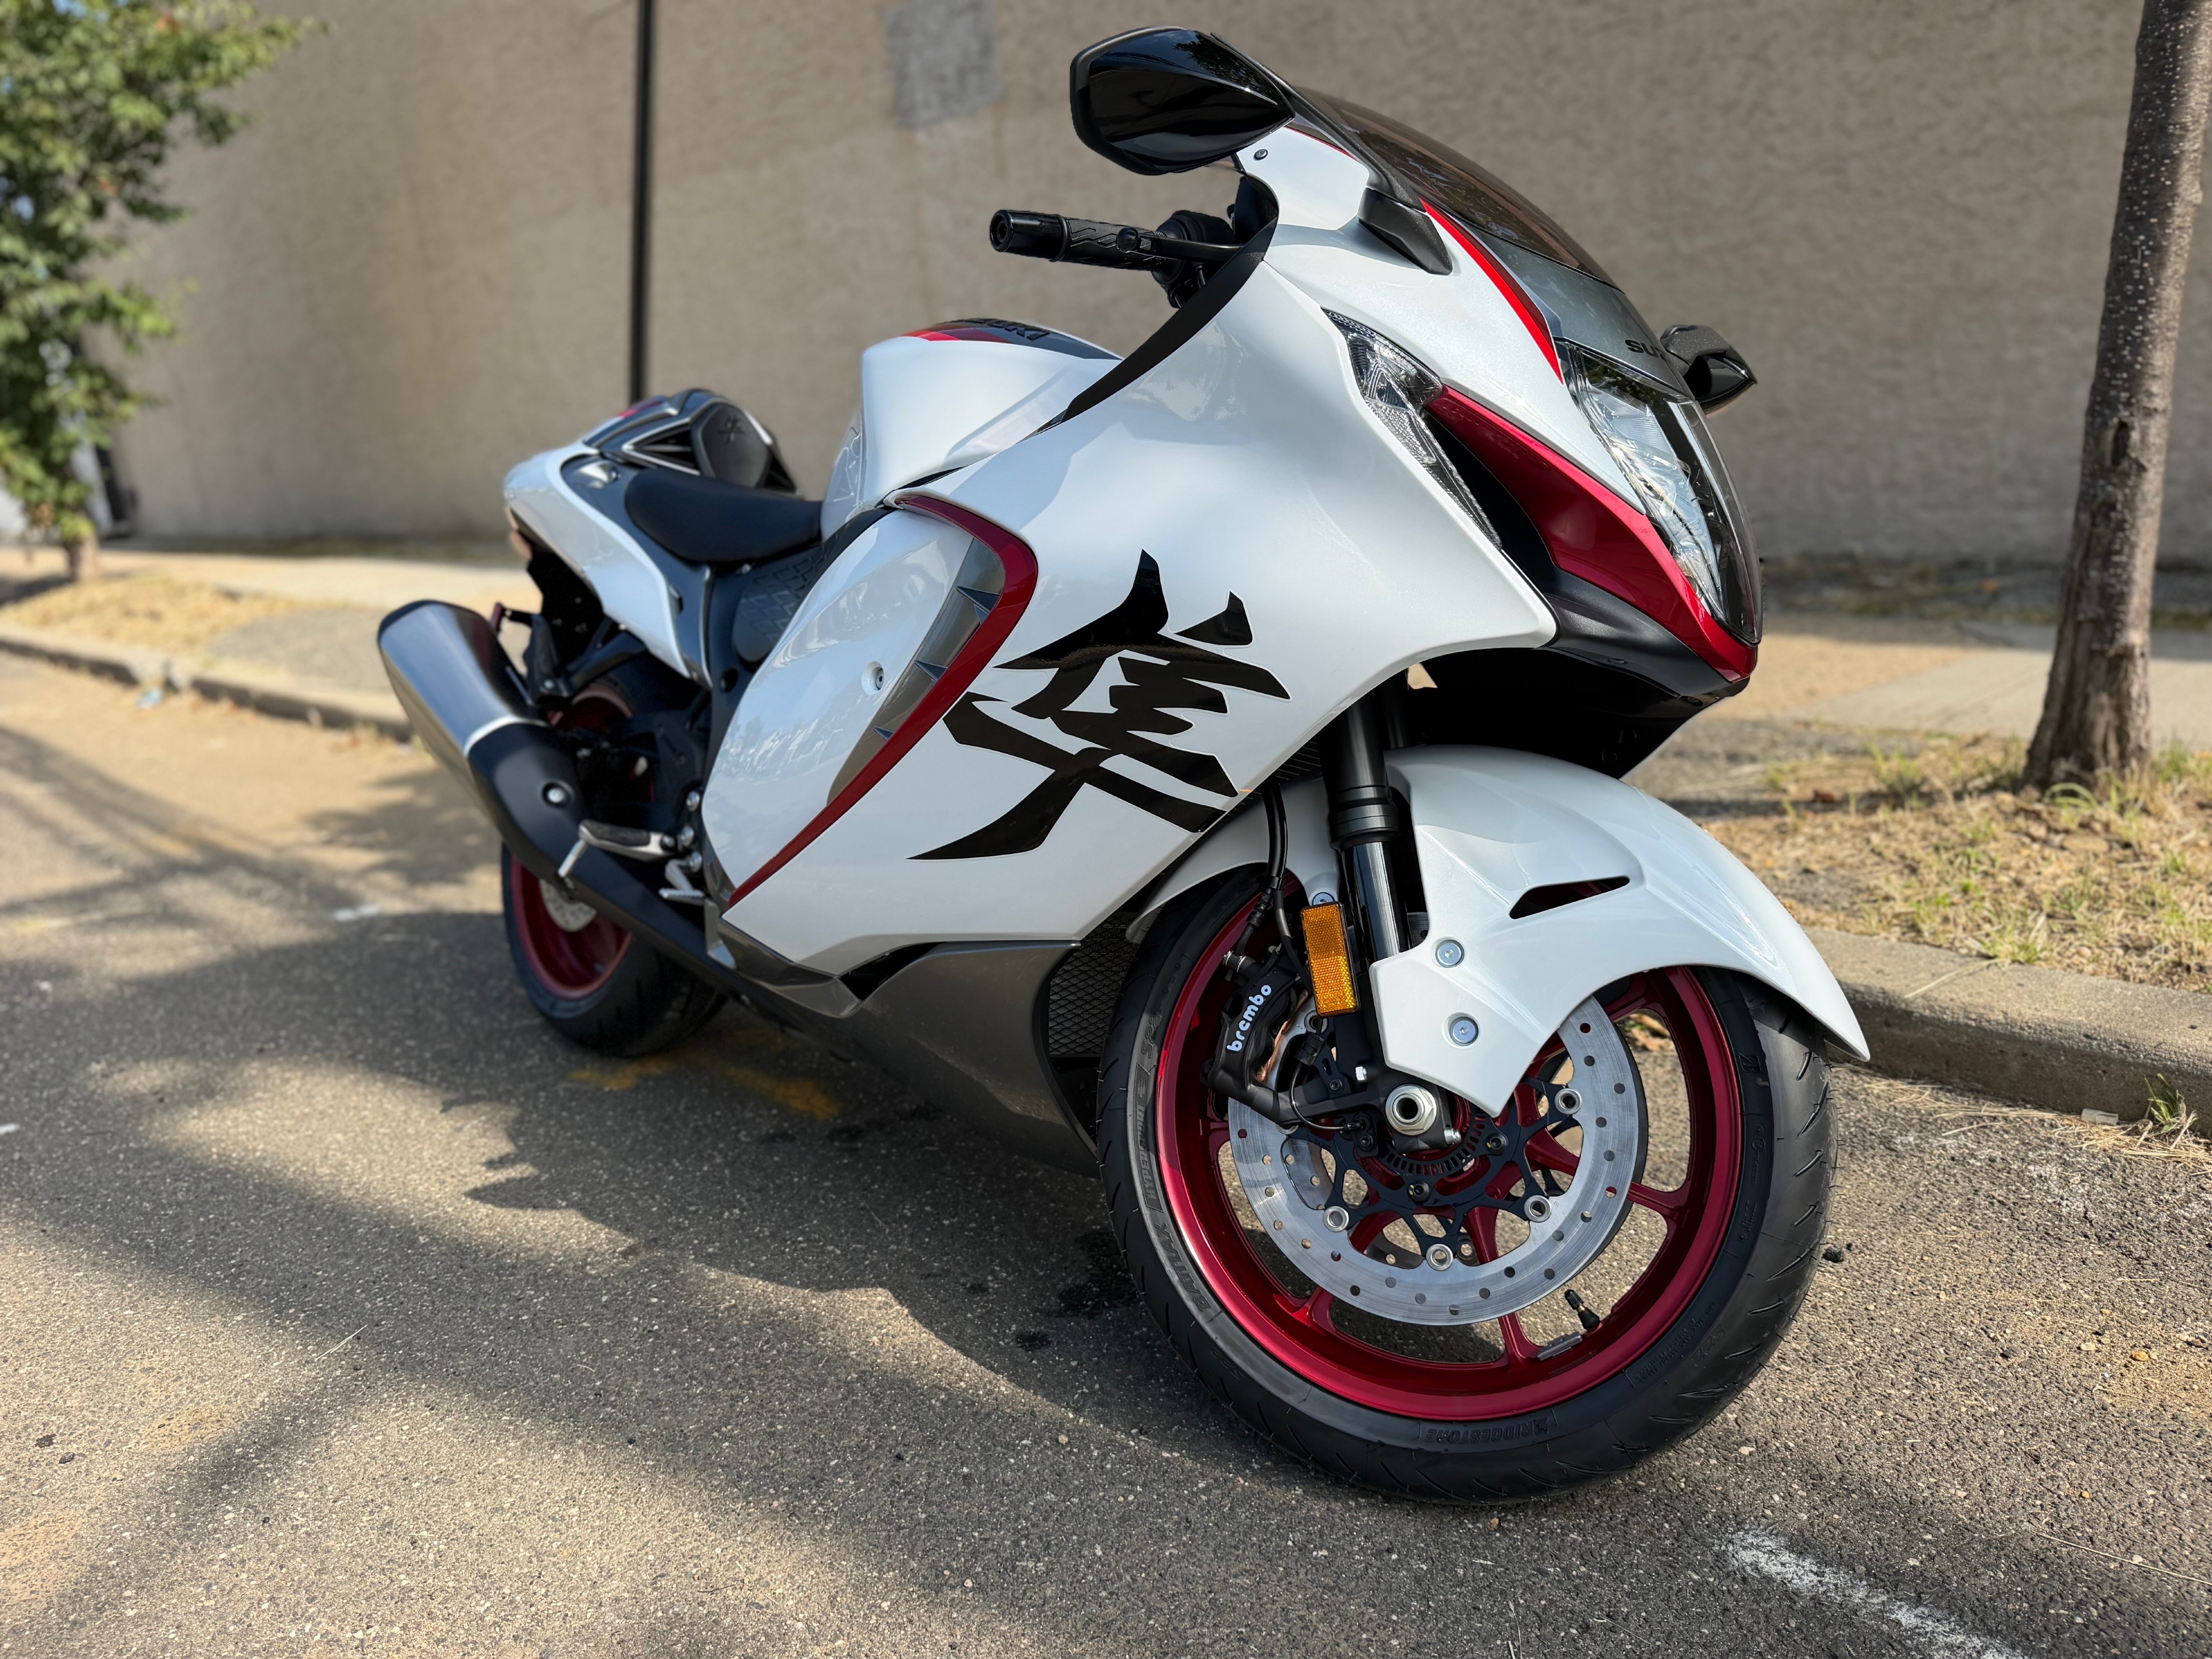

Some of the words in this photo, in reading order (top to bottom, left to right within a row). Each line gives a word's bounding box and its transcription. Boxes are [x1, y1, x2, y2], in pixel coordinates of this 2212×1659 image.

[1227, 985, 1272, 1051] brembo
[1153, 1221, 1212, 1312] BATTLAX
[1425, 1416, 1551, 1444] BRIDGESTONE
